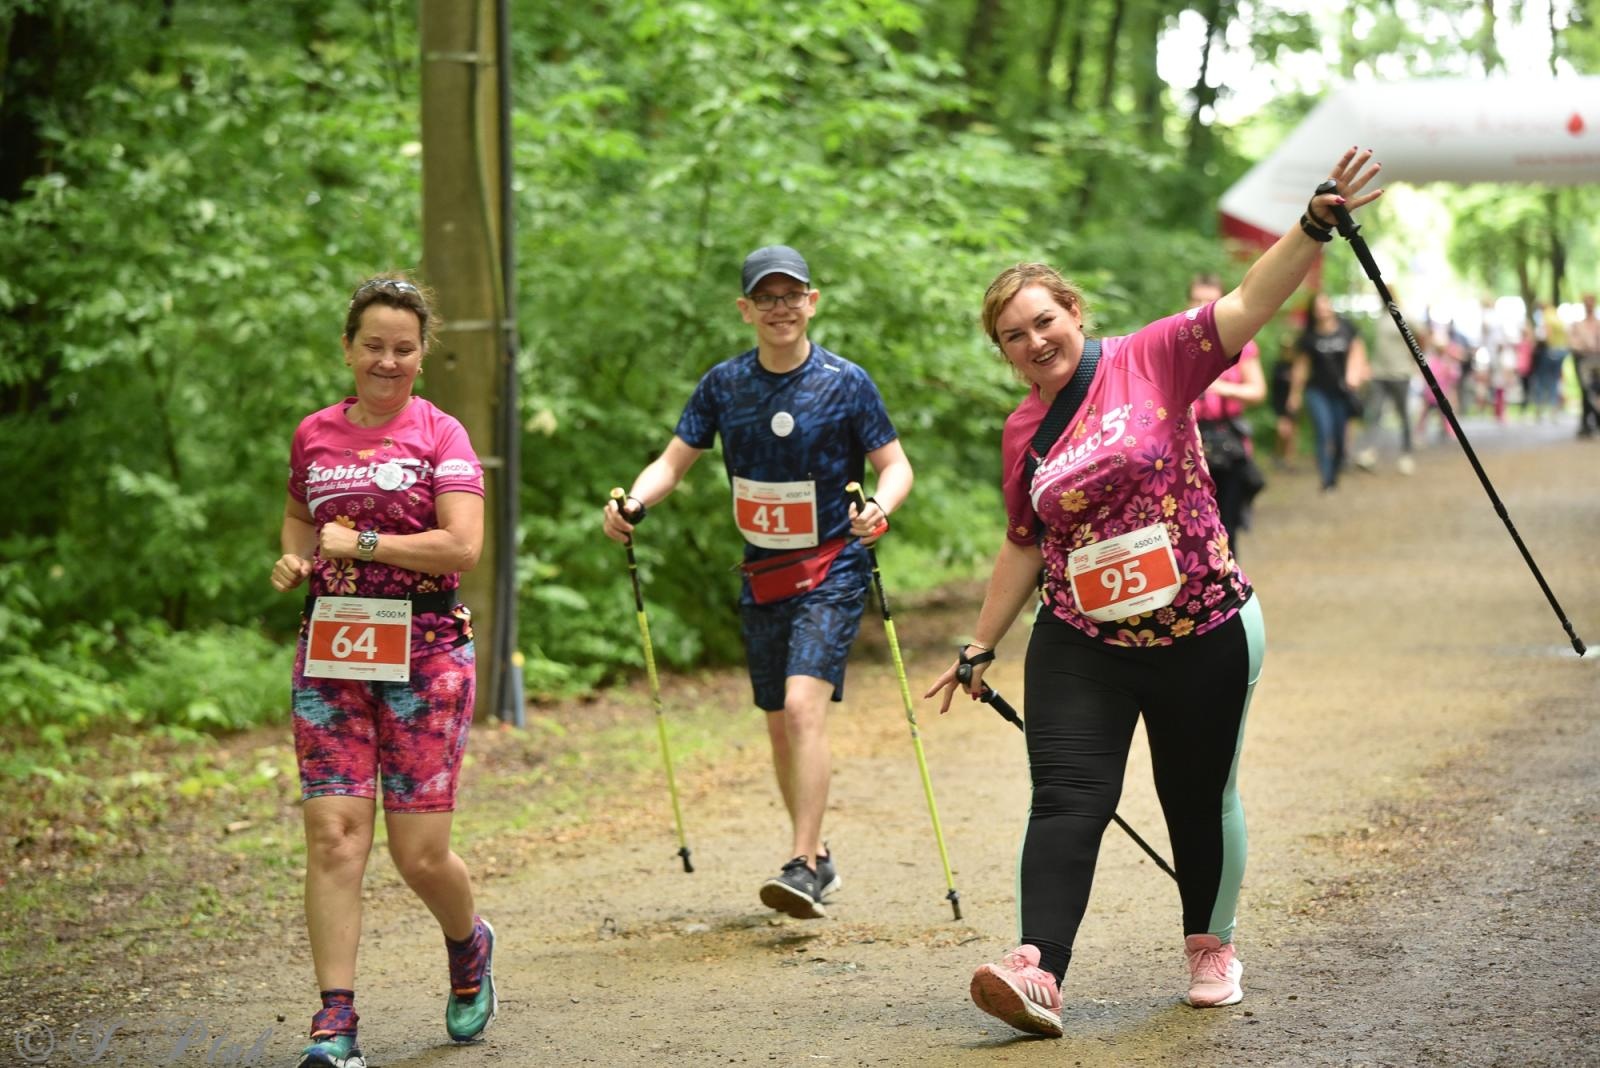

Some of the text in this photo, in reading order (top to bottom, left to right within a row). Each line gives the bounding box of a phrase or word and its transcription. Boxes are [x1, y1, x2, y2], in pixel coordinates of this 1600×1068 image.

[1398, 319, 1427, 367] SPRINGOS
[305, 461, 379, 483] Kobiet
[752, 504, 790, 533] 41
[1134, 535, 1163, 549] 4500 M
[1100, 559, 1148, 601] 95
[375, 610, 397, 619] 4500
[398, 611, 407, 619] M
[331, 625, 378, 660] 64
